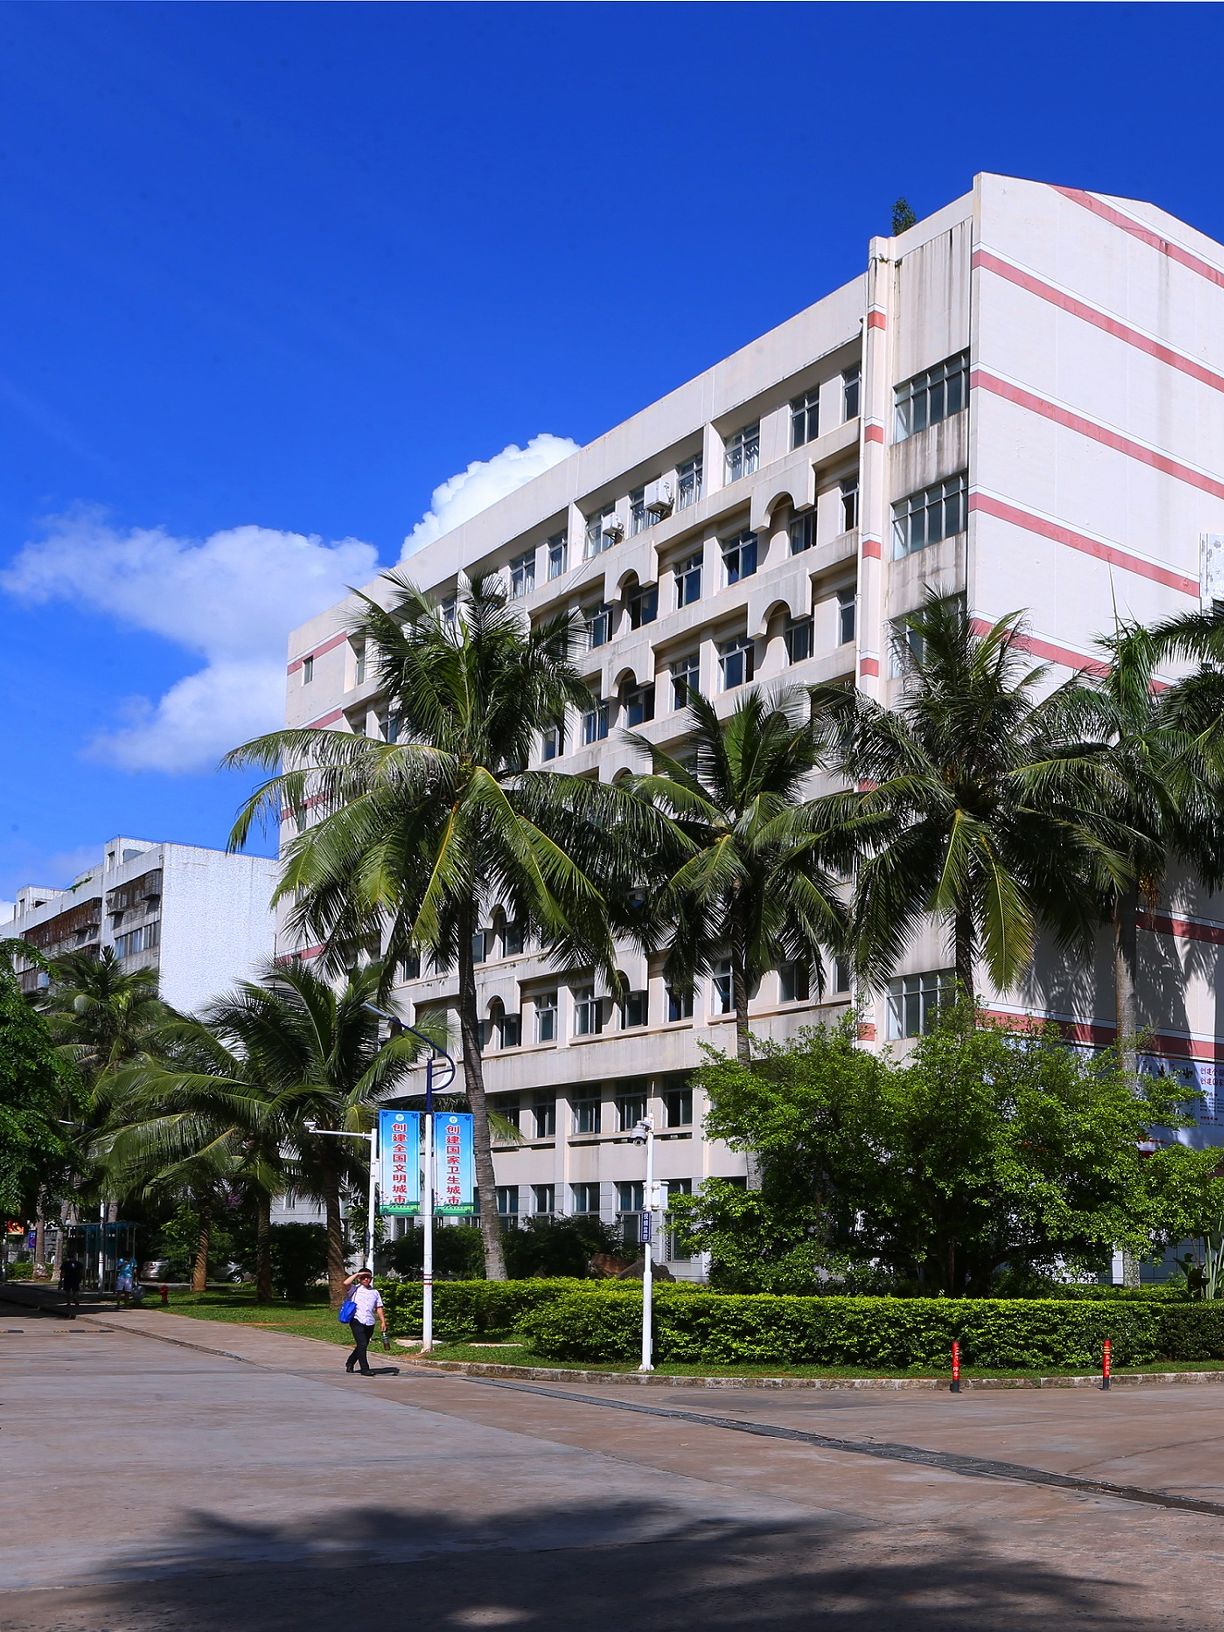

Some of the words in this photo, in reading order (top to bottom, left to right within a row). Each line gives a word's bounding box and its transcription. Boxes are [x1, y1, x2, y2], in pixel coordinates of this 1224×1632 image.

[393, 1123, 407, 1204] 创建全国文明城市
[446, 1125, 461, 1205] 创建国家卫生城市
